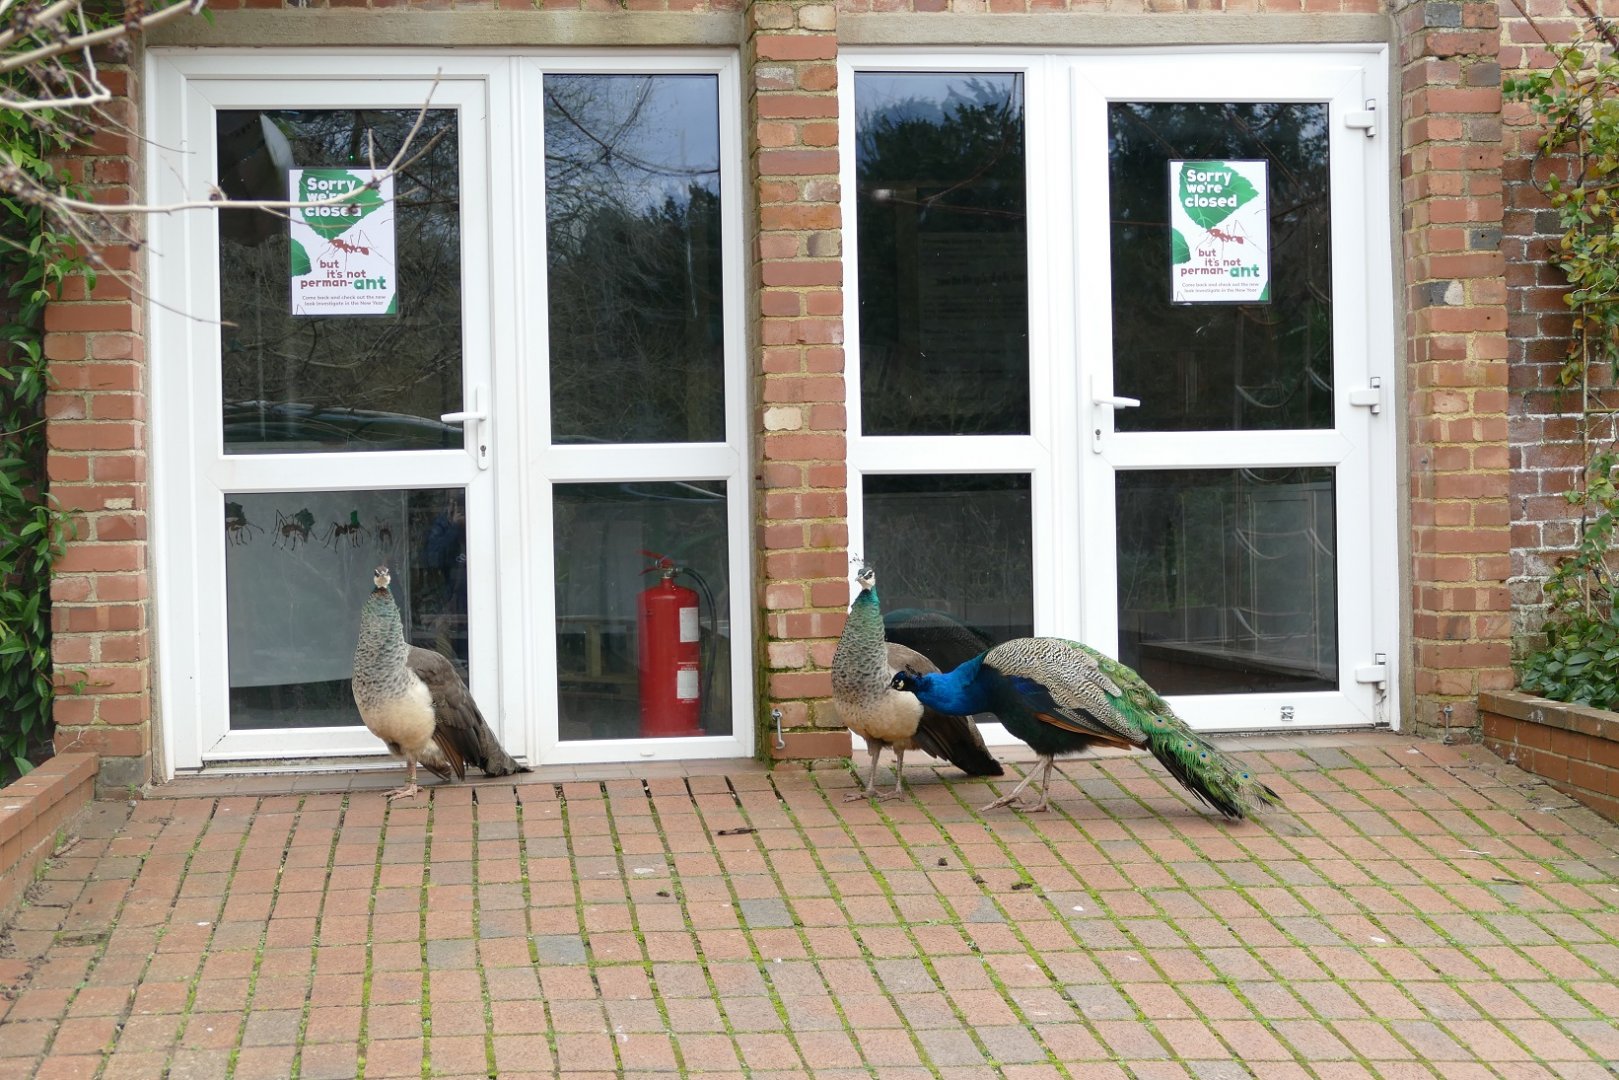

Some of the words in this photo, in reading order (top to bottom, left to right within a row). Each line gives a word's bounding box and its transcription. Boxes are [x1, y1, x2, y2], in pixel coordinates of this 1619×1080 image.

[1186, 169, 1232, 186] Sorry
[307, 177, 355, 193] Sorry
[1186, 181, 1222, 193] we're
[1184, 194, 1237, 207] closed
[1198, 248, 1216, 257] but
[320, 260, 339, 268] but
[1204, 258, 1220, 266] it's
[1223, 258, 1241, 266] not
[327, 270, 342, 278] it's
[346, 270, 366, 278] not
[1180, 264, 1260, 277] perman-ant
[301, 276, 386, 290] perman-ant
